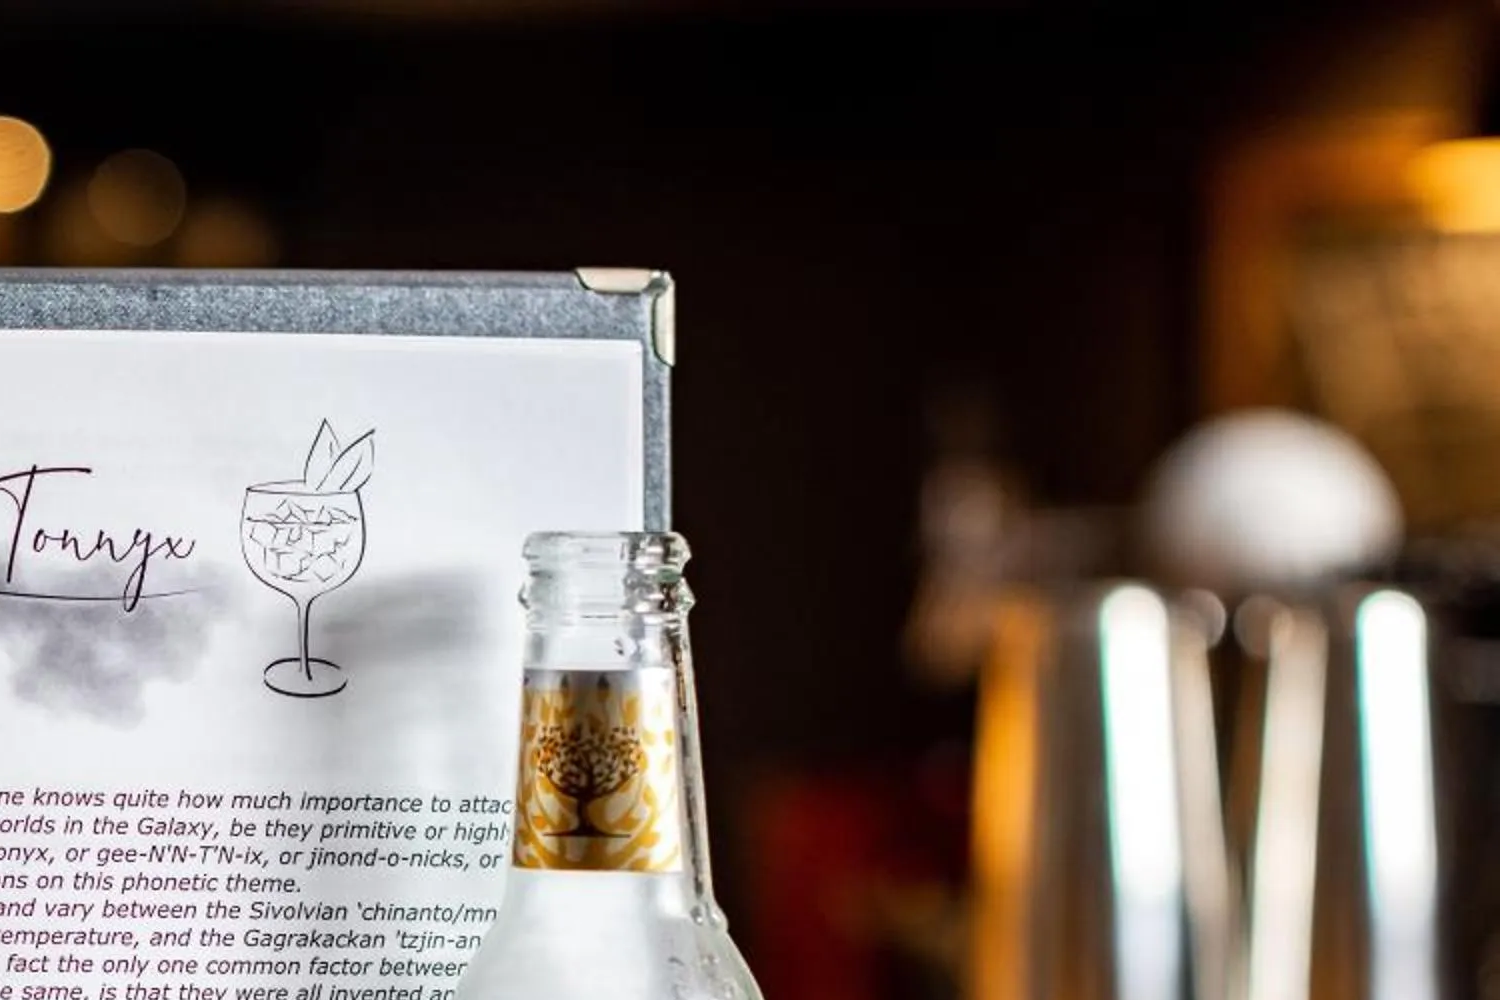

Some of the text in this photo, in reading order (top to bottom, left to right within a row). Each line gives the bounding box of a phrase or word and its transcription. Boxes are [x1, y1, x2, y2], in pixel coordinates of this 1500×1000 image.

[32, 786, 106, 808] knows
[112, 788, 170, 812] quite
[176, 788, 225, 809] how
[230, 790, 293, 811] much
[299, 791, 424, 816] importance
[430, 794, 452, 814] to
[458, 795, 510, 815] attac
[64, 847, 91, 863] or
[278, 850, 305, 866] or
[305, 846, 470, 873] jinond-o-nicks,
[478, 853, 503, 870] or
[149, 927, 193, 948] and
[199, 927, 236, 948] the
[242, 927, 386, 953] Gagrakackan
[395, 929, 482, 954] 'tzjin-an
